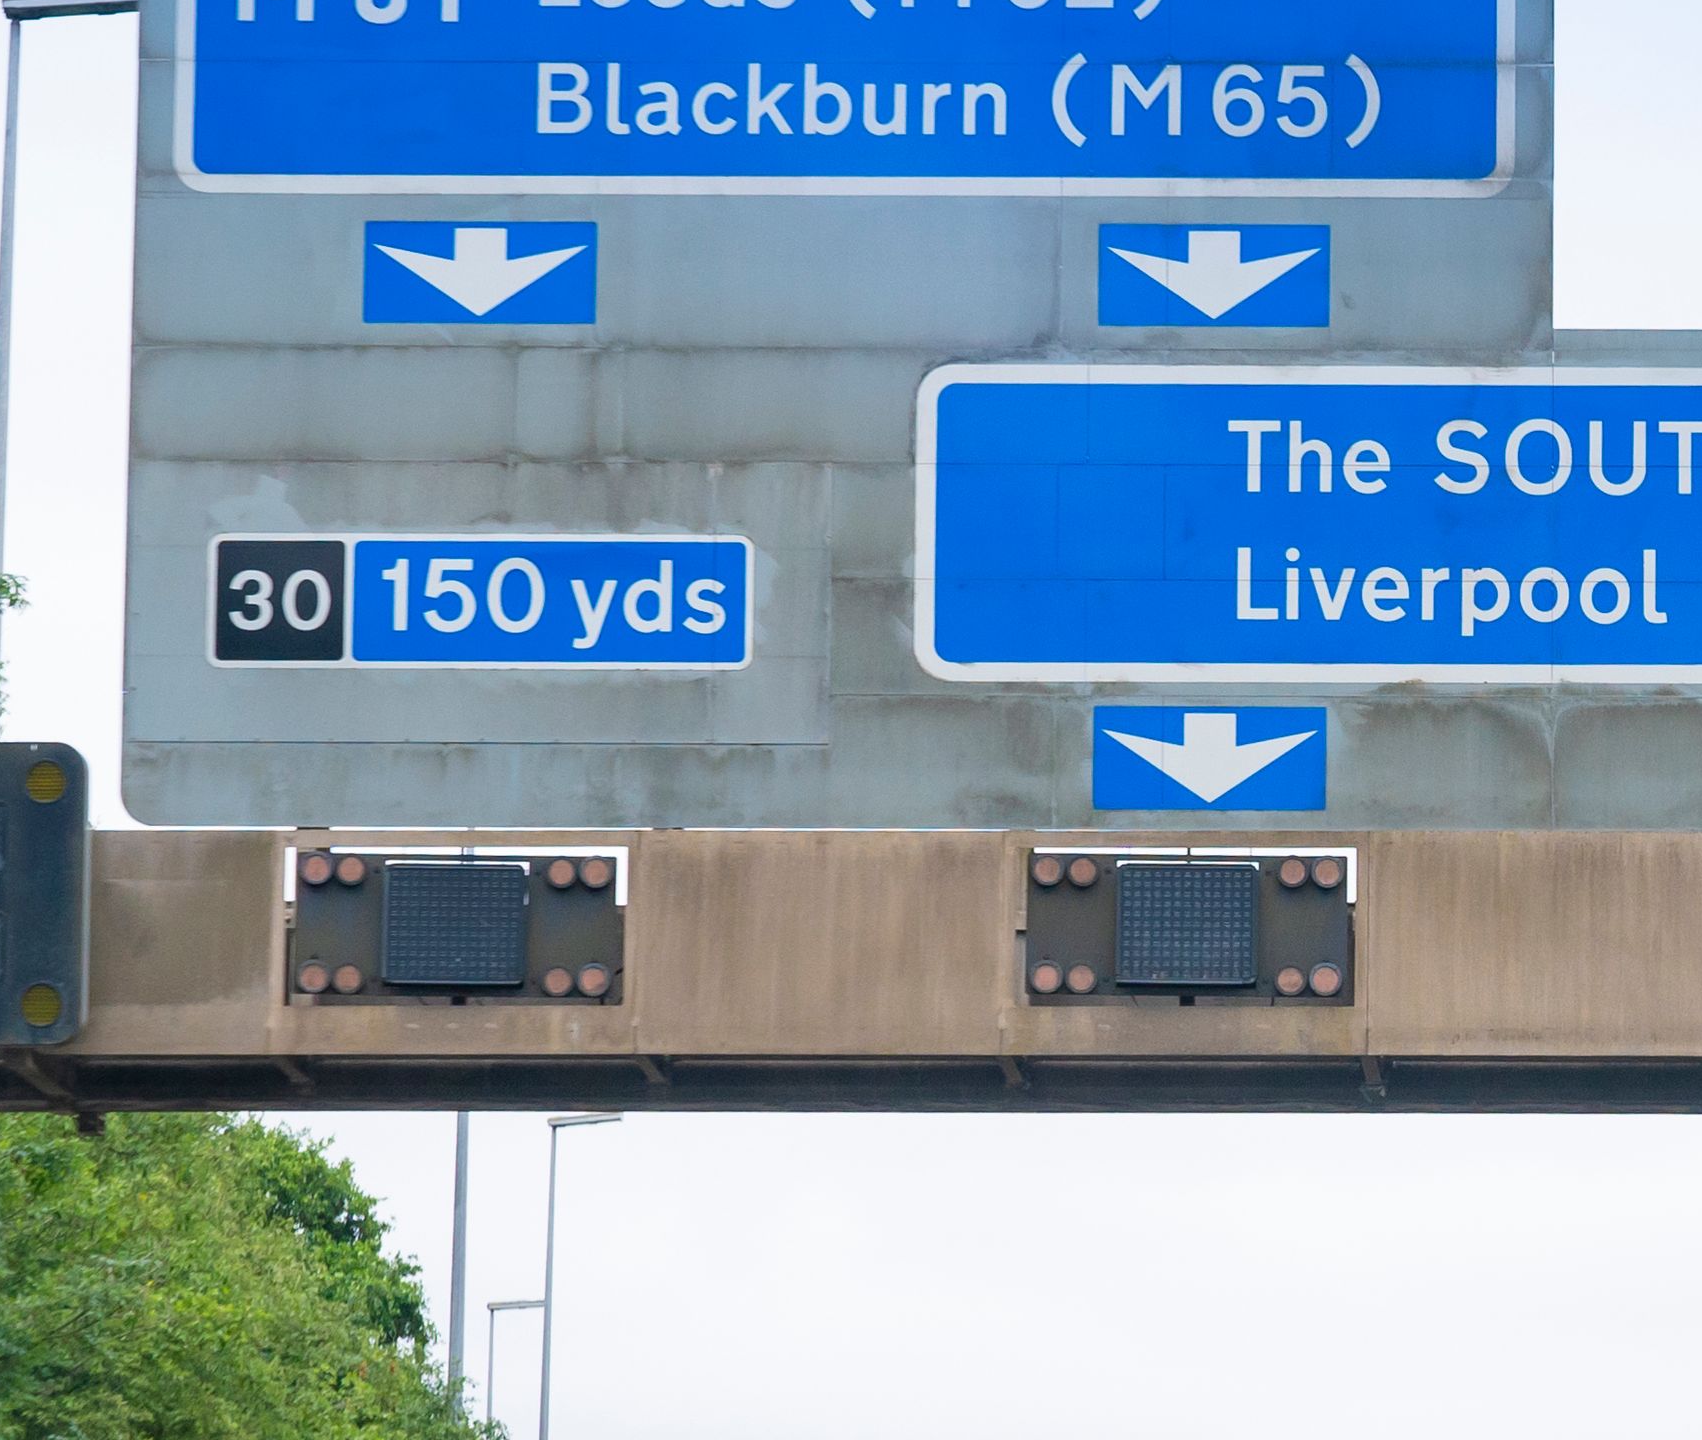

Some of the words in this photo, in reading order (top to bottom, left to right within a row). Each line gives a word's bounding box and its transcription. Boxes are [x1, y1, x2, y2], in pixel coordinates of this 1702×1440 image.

[536, 61, 1008, 137] Blackburn
[1226, 419, 1392, 495] The
[228, 568, 333, 632] 30
[381, 556, 546, 635] 150
[570, 558, 727, 650] yds
[1235, 546, 1669, 638] Liverpool
